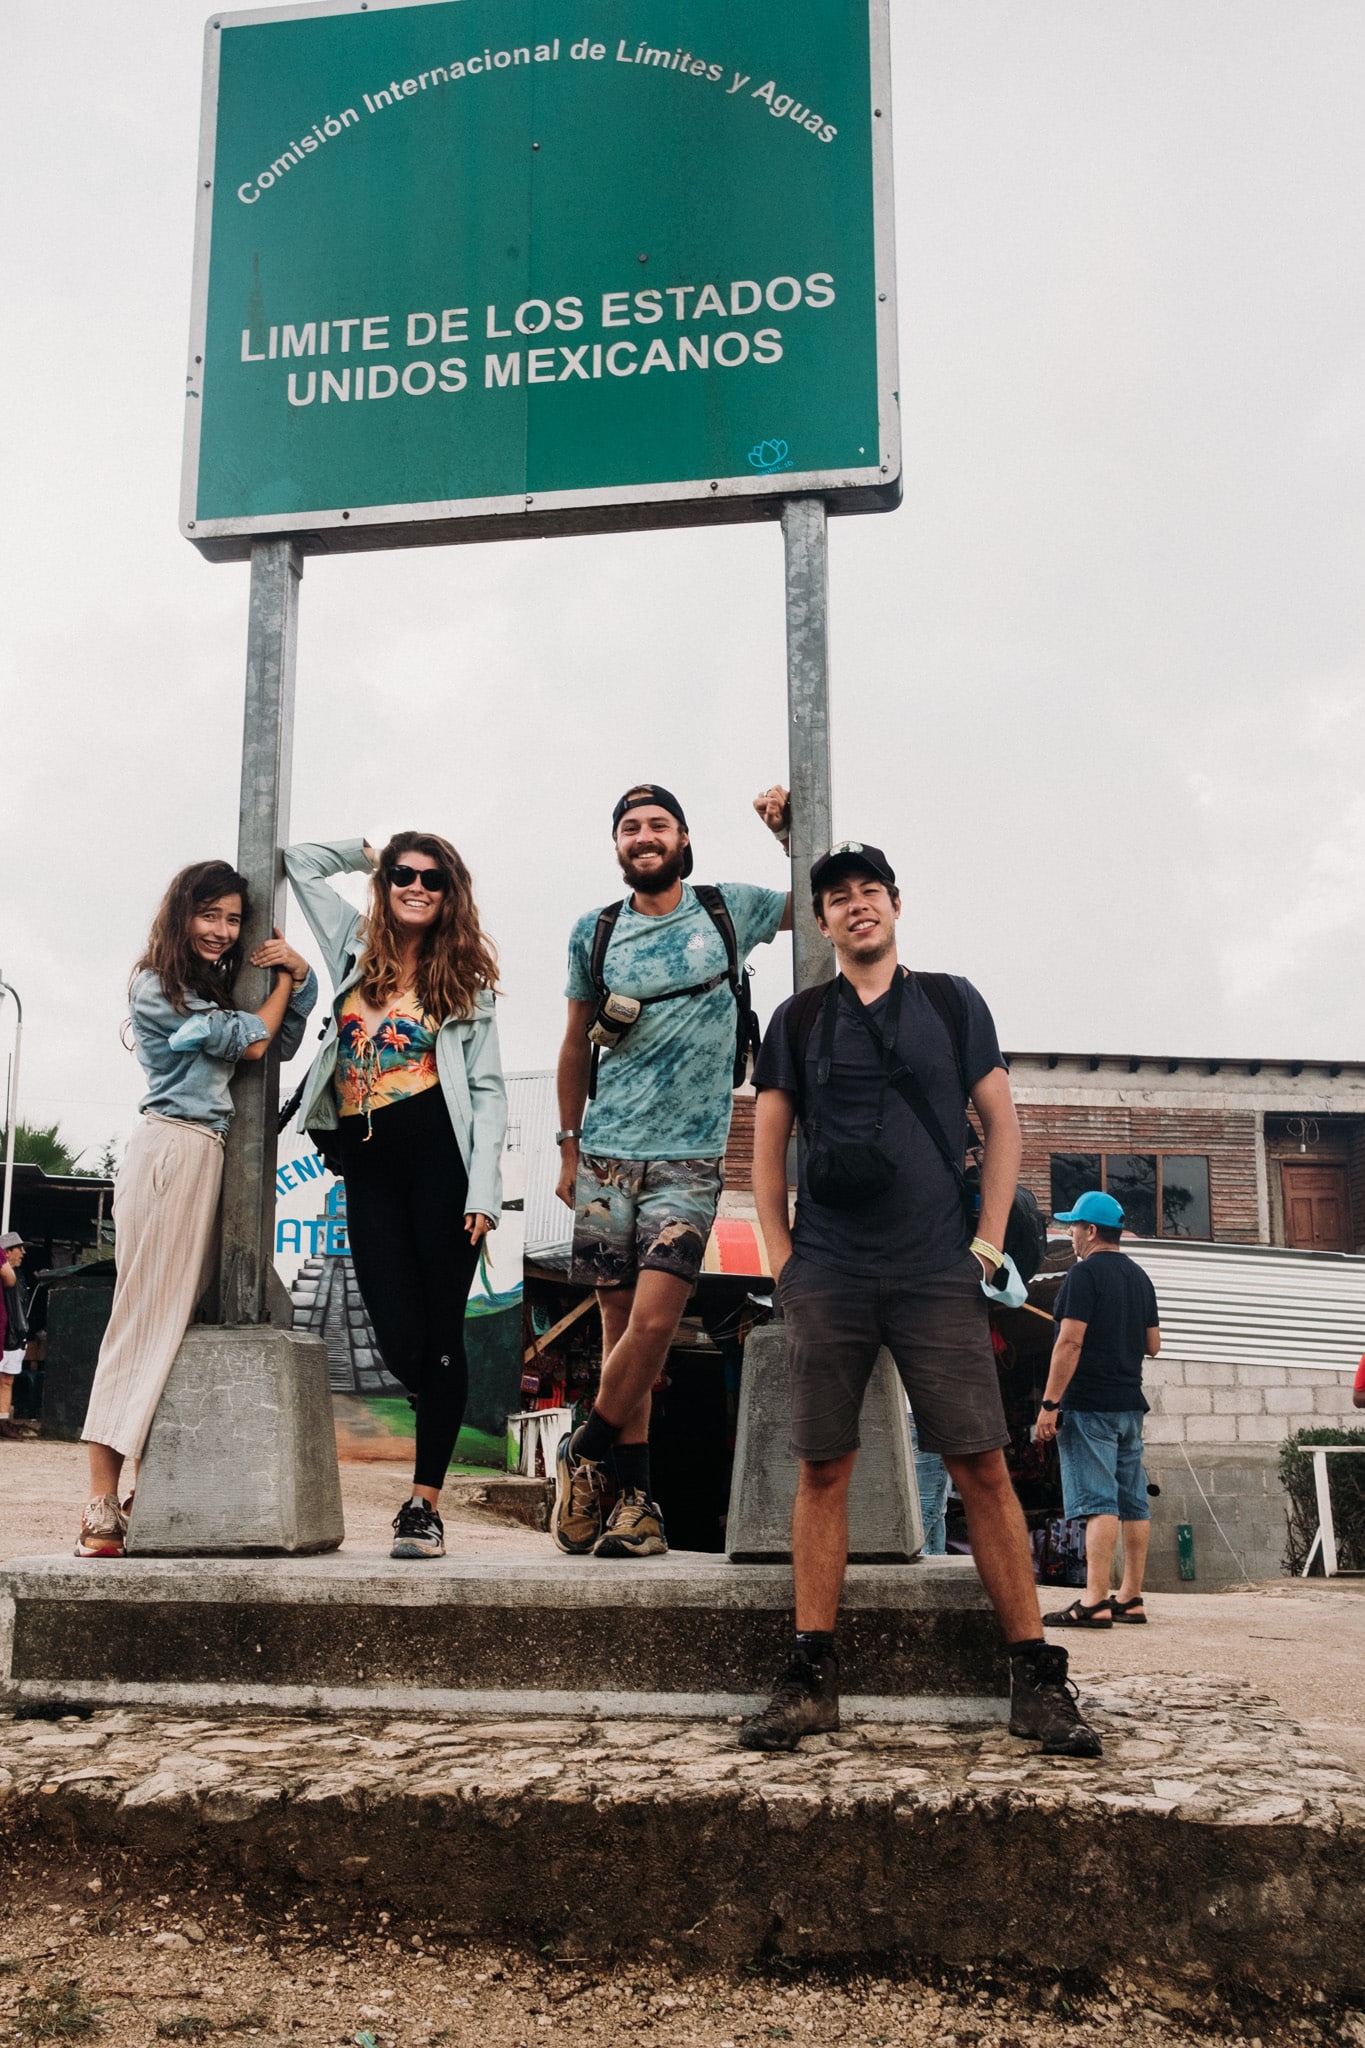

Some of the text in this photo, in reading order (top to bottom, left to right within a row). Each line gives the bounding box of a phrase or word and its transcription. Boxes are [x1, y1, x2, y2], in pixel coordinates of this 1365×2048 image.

[238, 37, 838, 205] Comisión Internacional de Límites y Aguas
[240, 272, 836, 363] LIMITE DE LOS ESTADOS
[287, 328, 784, 407] UNIDOS MEXICANOS
